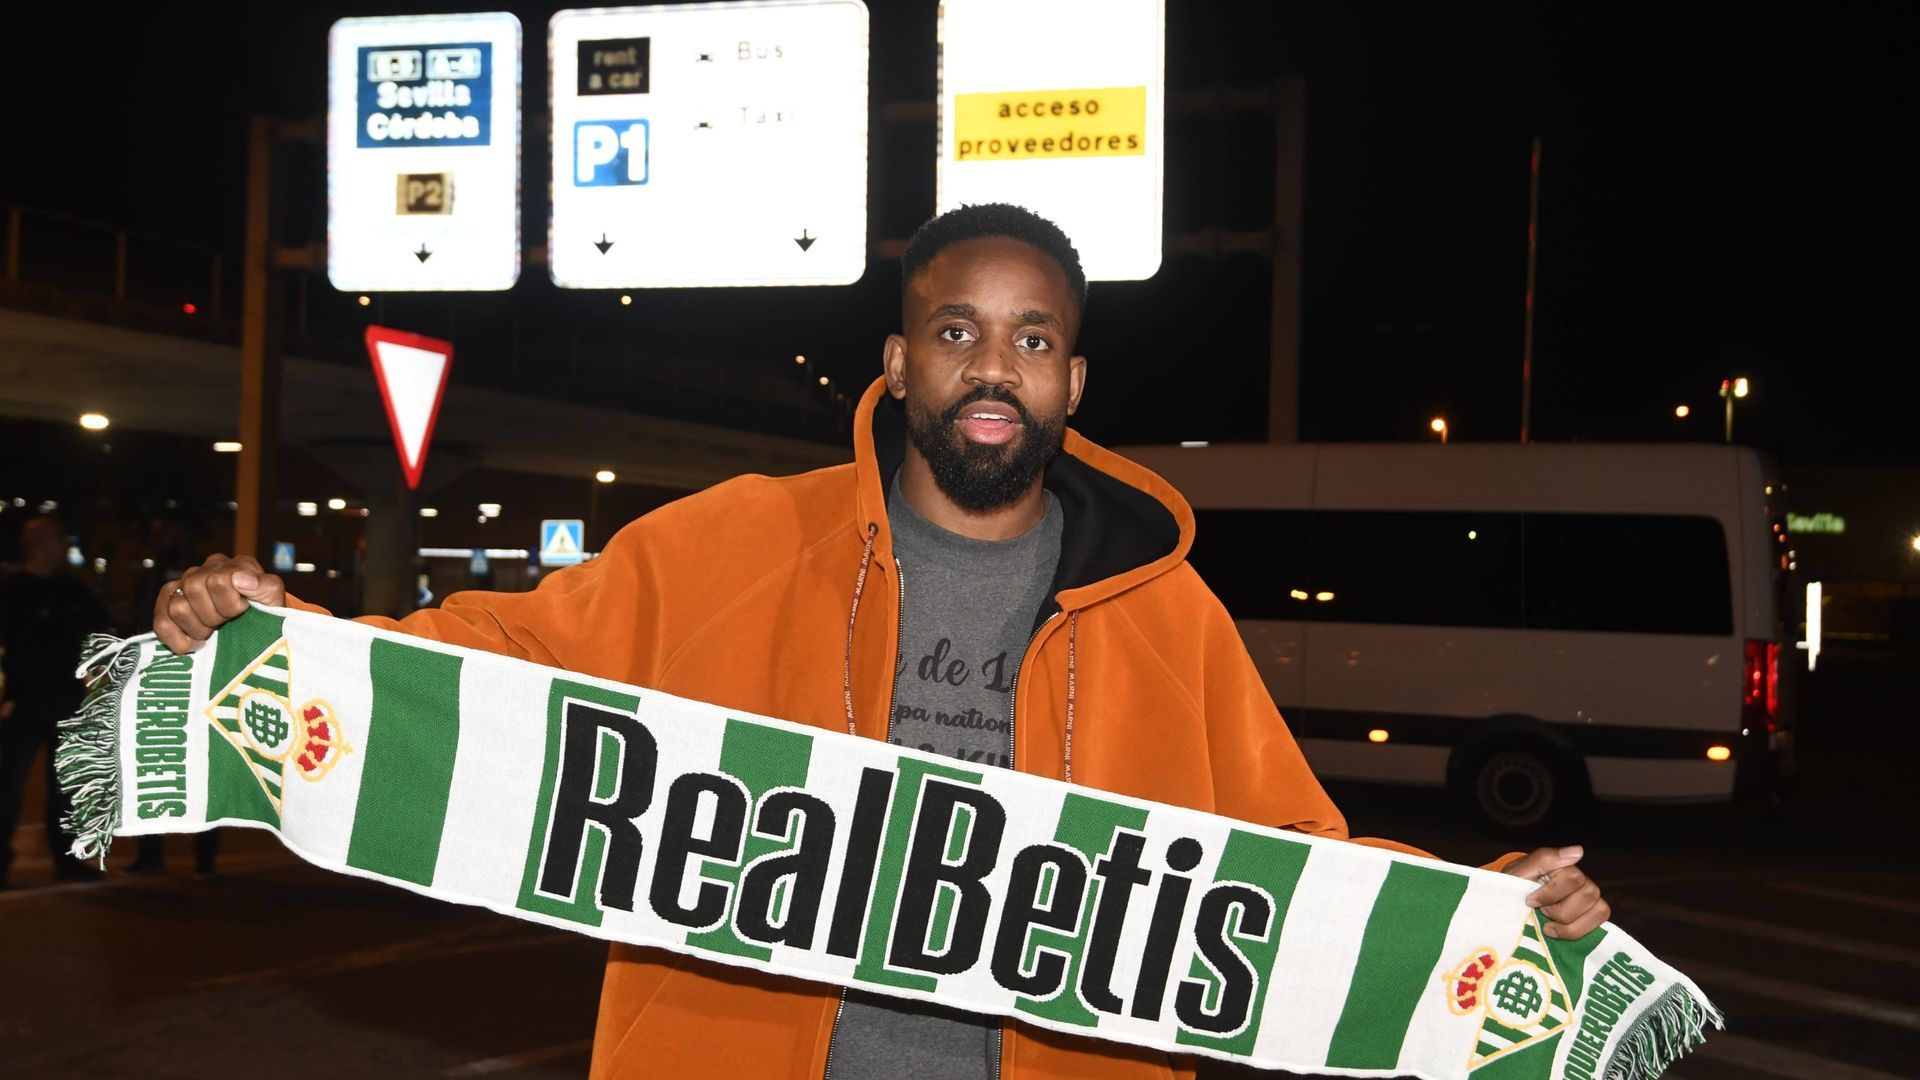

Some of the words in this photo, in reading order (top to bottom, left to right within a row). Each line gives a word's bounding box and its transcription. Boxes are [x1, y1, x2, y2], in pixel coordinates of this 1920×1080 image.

[593, 47, 636, 66] rent
[738, 40, 783, 60] Bus
[589, 73, 602, 89] a
[608, 70, 642, 89] car
[377, 81, 471, 109] Sevilla
[998, 100, 1099, 118] acceso
[577, 123, 646, 182] P1
[959, 132, 1138, 158] proveedores
[408, 180, 441, 206] P2
[855, 569, 867, 596] MARNI
[919, 638, 970, 686] de
[1068, 672, 1076, 700] MARNI
[1066, 703, 1075, 730] MARNI
[136, 645, 194, 820] QUIEROBETIS
[1064, 733, 1072, 760] MARNI
[1064, 764, 1072, 783] MAR
[1563, 952, 1655, 1080] QUIEROBETIS
